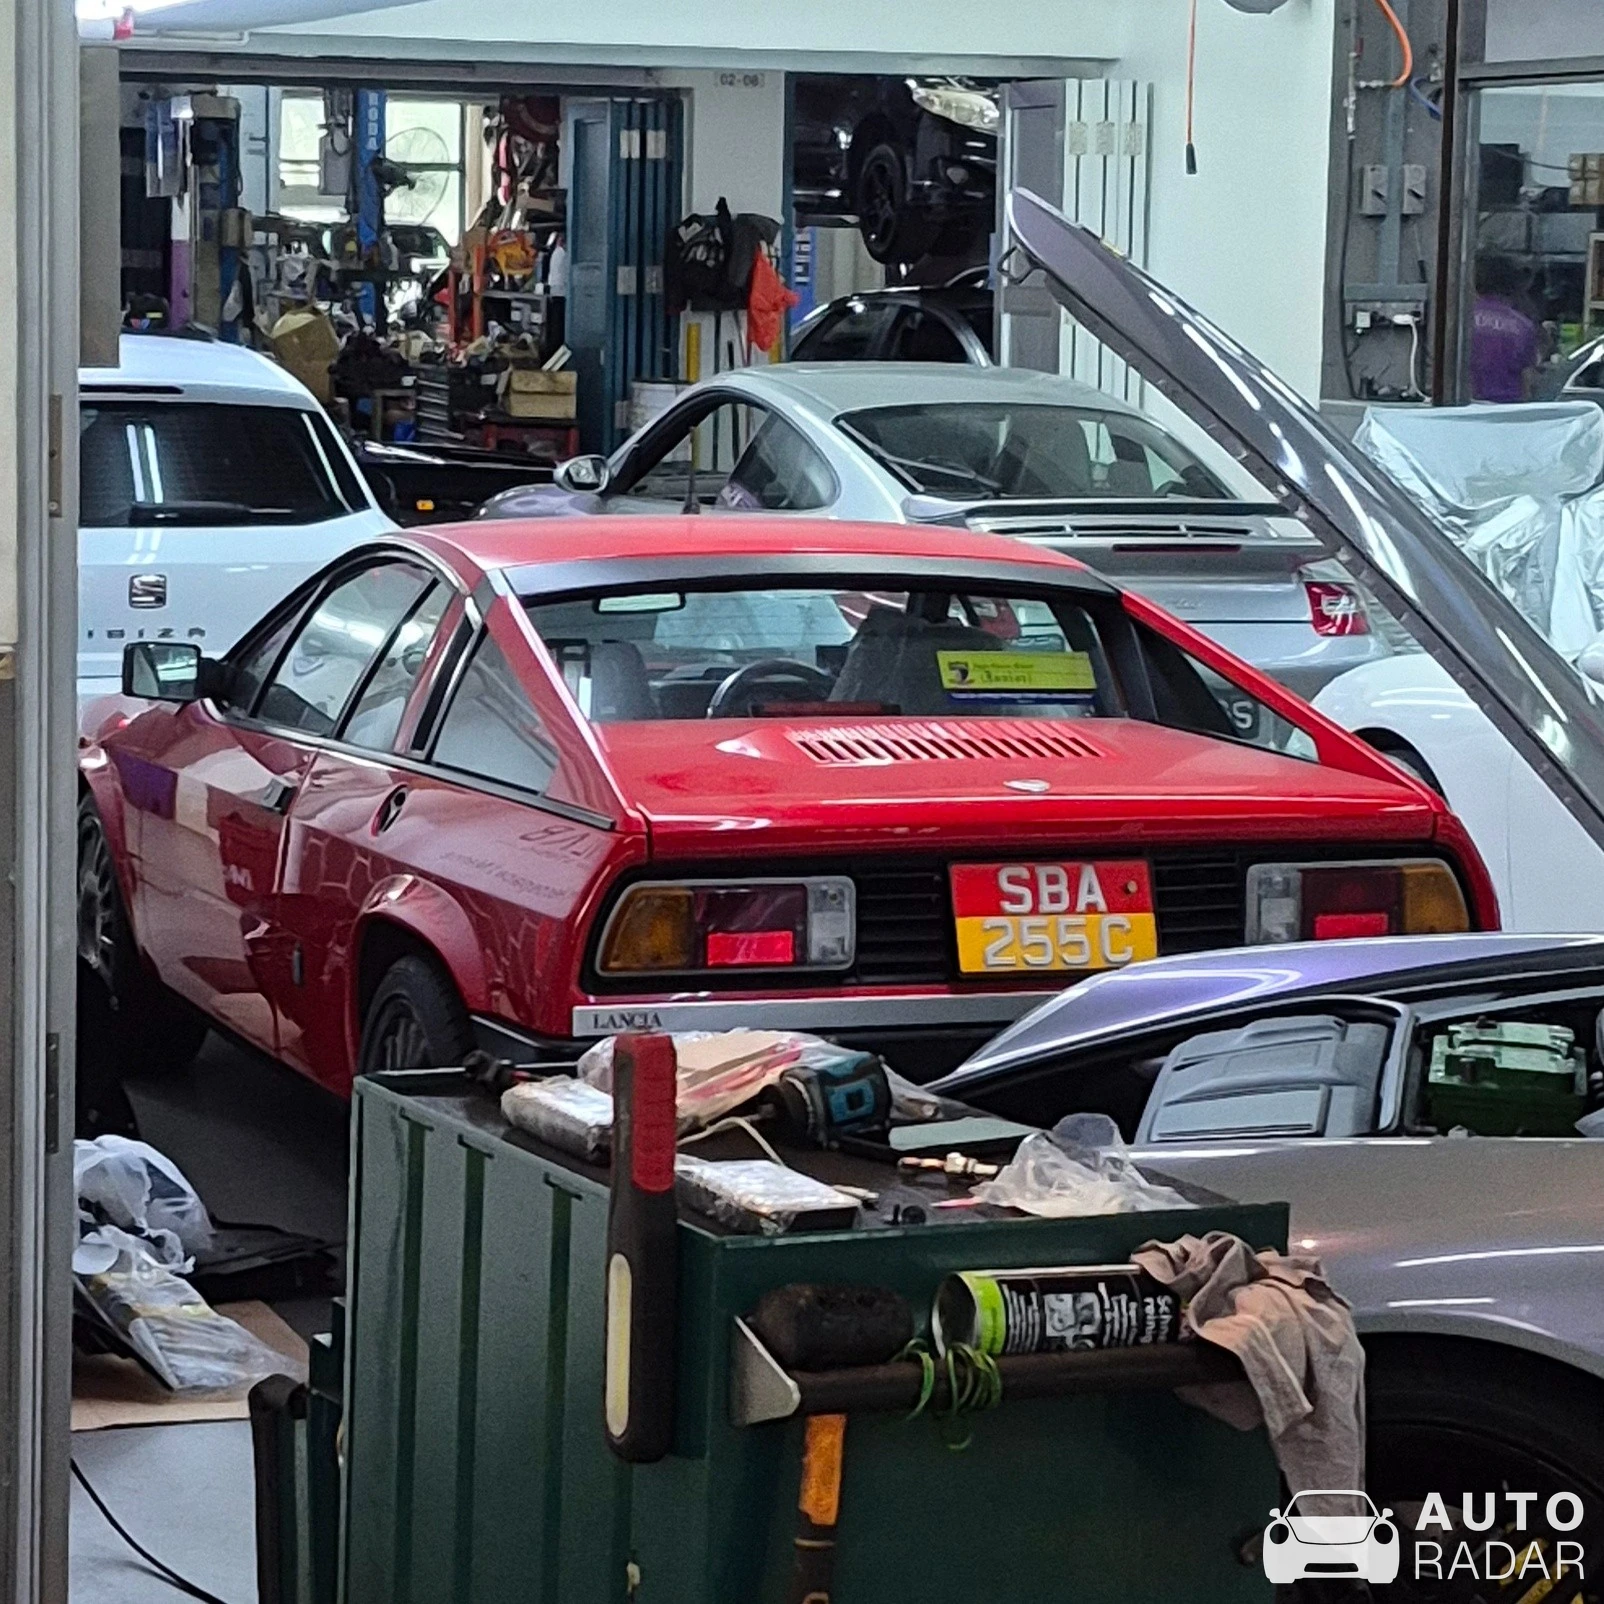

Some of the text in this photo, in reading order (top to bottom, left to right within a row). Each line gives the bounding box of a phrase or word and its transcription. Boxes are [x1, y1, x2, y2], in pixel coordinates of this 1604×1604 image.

[87, 627, 206, 639] IBIZA
[998, 864, 1108, 914] SBA
[983, 915, 1134, 966] 255C
[592, 1011, 663, 1030] LANCIA
